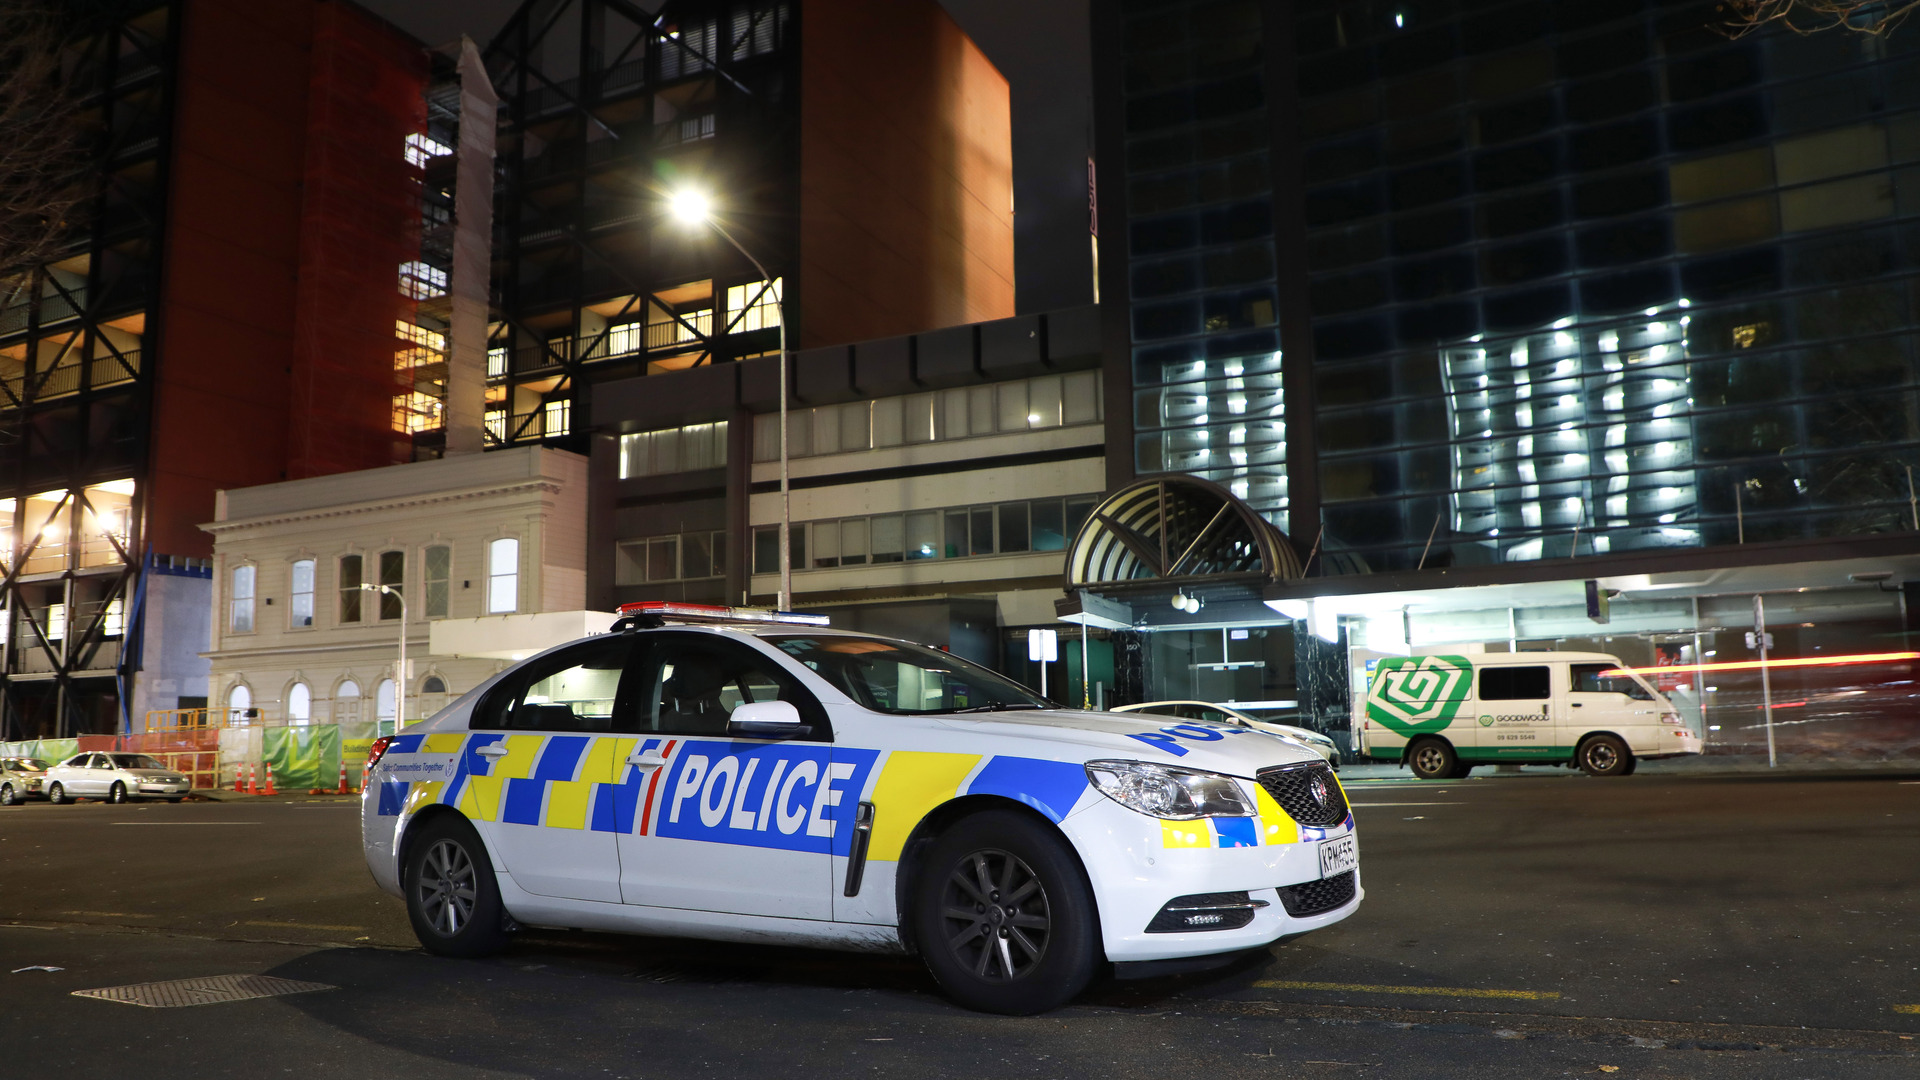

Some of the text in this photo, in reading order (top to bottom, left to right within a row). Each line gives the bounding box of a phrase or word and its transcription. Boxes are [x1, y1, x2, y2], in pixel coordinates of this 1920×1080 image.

[393, 763, 422, 772] Communities
[422, 762, 444, 774] Together
[669, 754, 856, 838] POLICE
